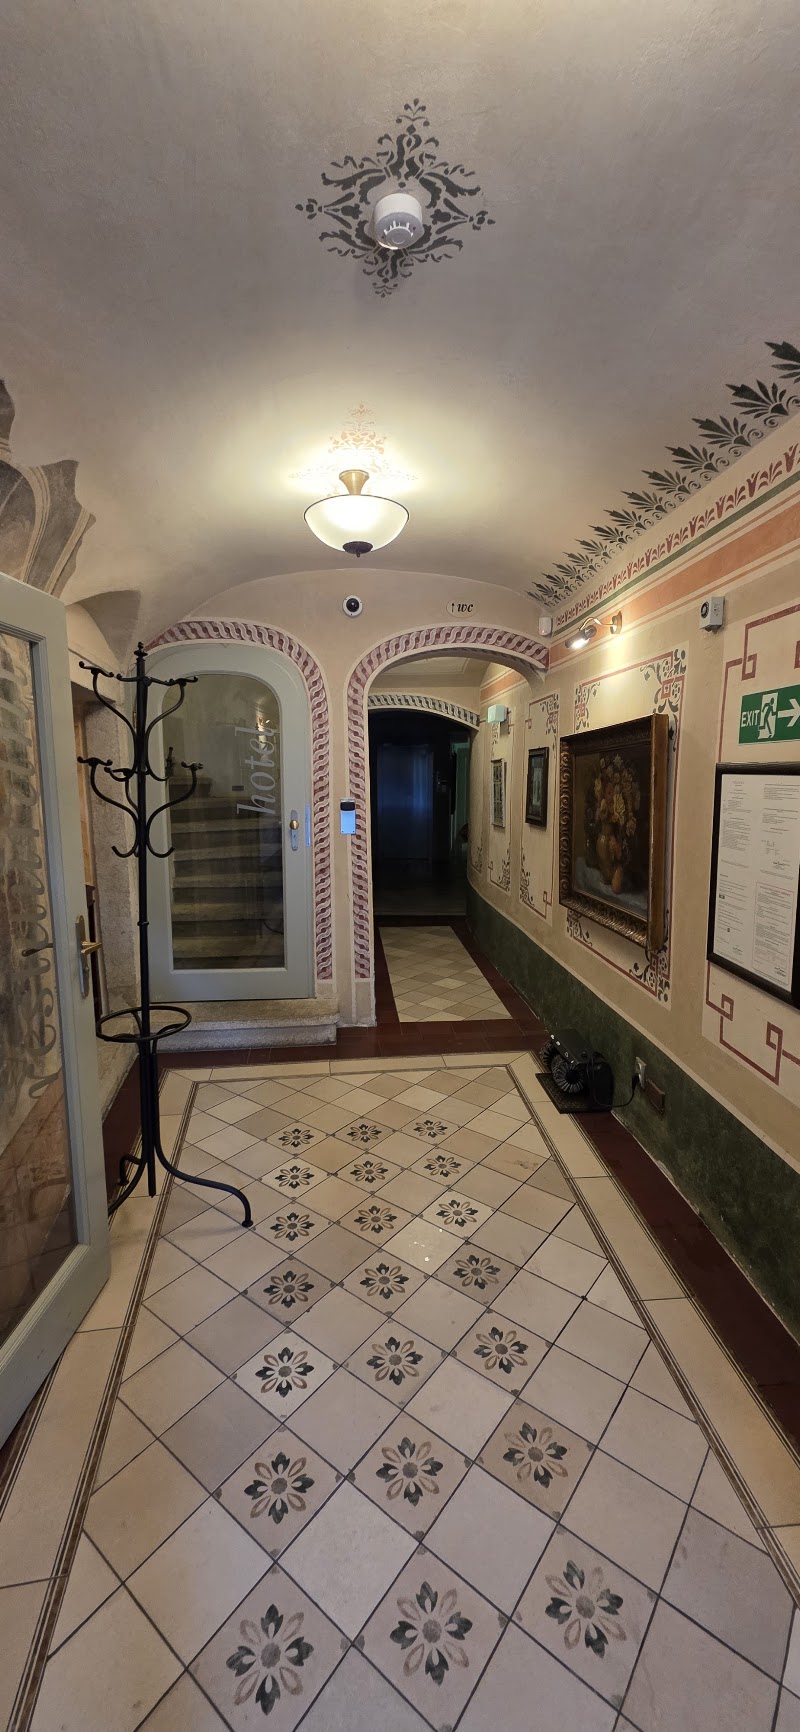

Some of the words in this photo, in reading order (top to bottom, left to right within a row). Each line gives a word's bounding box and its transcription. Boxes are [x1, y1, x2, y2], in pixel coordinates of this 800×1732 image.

[457, 603, 474, 613] wc
[741, 710, 760, 727] EXIT
[235, 727, 275, 814] hotel
